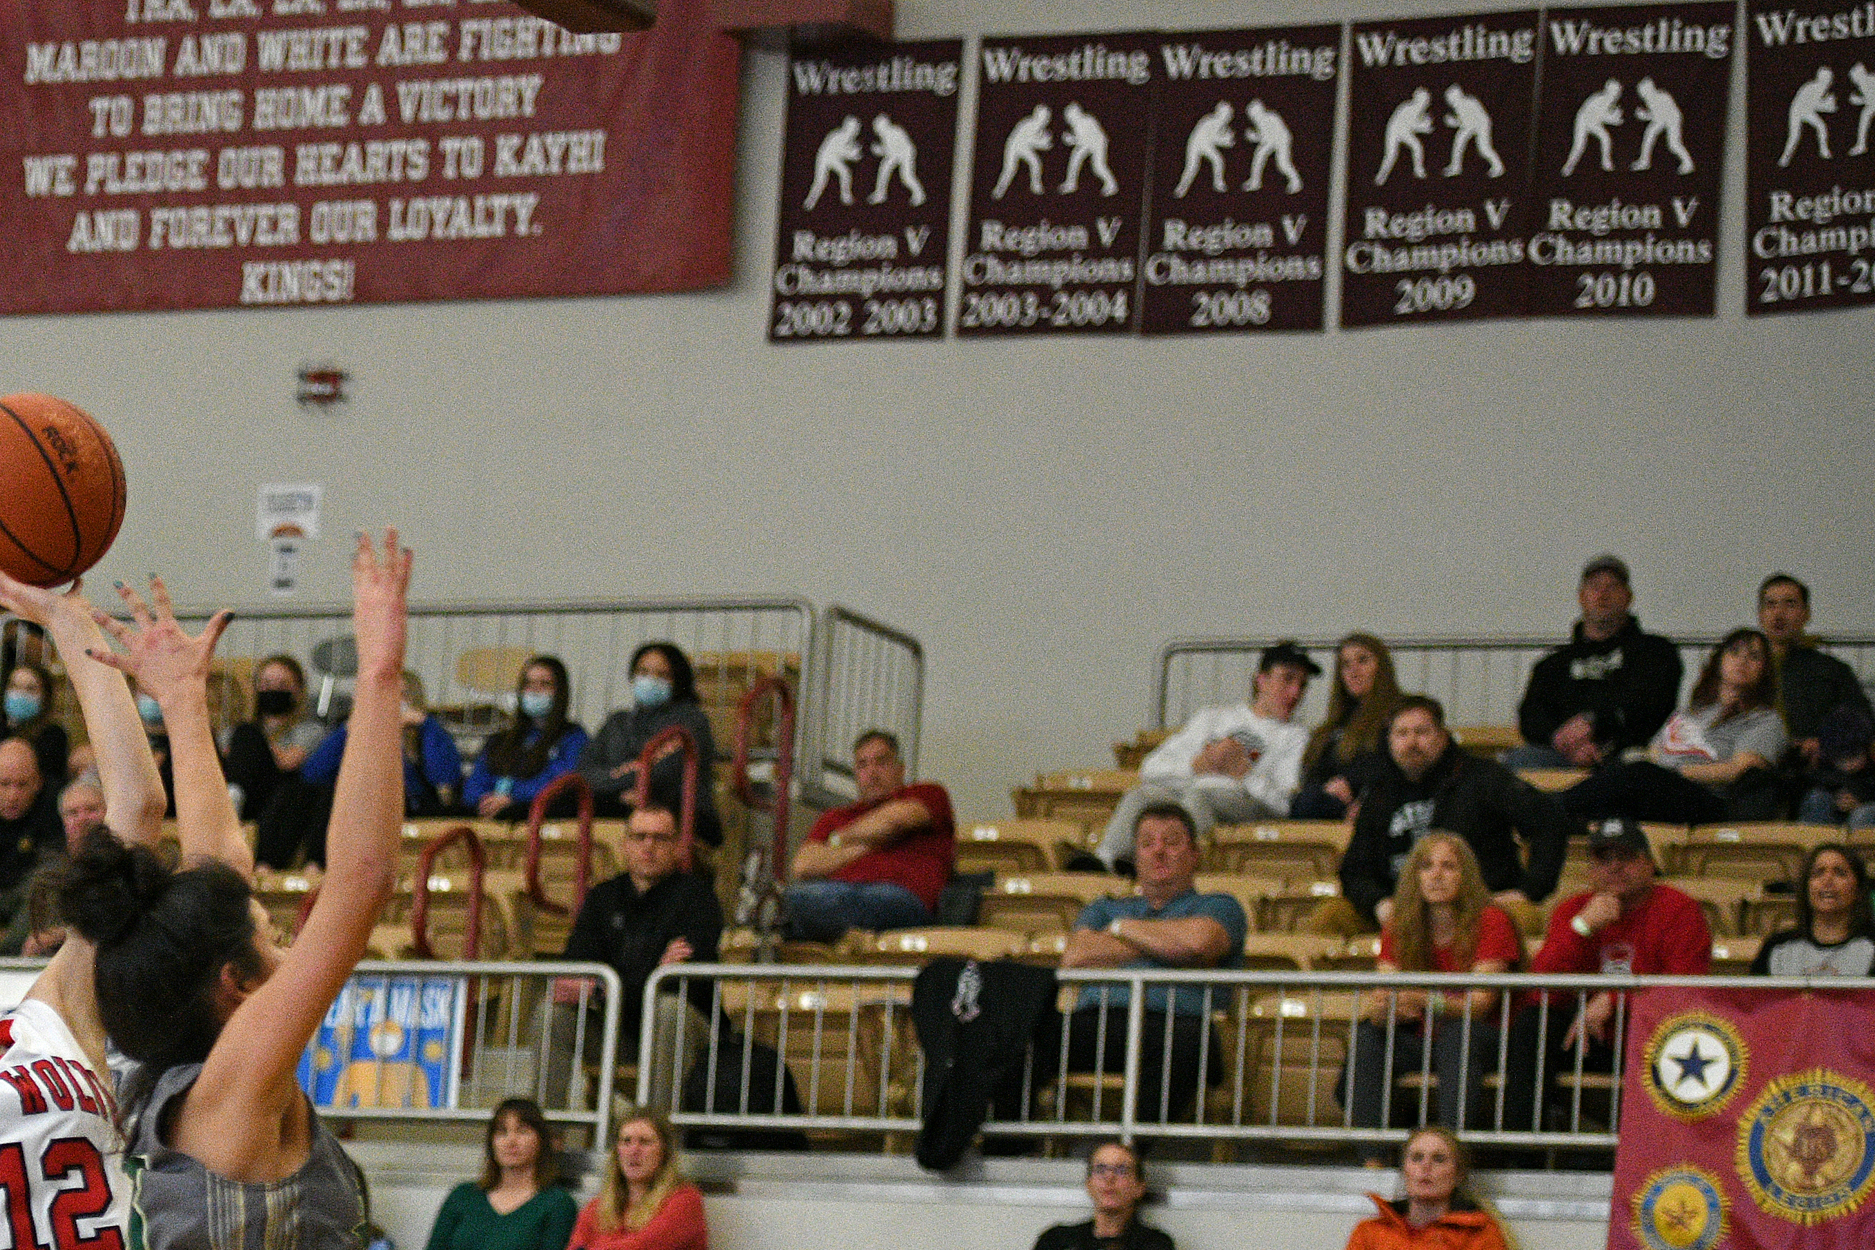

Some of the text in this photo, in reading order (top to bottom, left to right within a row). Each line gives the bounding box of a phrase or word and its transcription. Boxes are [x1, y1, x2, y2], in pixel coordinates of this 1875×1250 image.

[27, 36, 166, 83] MAROON
[173, 33, 247, 77] AND
[257, 25, 370, 73] WHITE
[376, 21, 450, 66] ARE
[1356, 23, 1535, 64] Wrestling
[1550, 18, 1731, 59] Wrestling
[793, 57, 959, 96] Wrestling
[983, 42, 1152, 85] Wrestling
[1161, 40, 1335, 81] Wrestling
[90, 72, 543, 139] TO BRING HOME A VICTORY
[23, 130, 607, 197] WE PLEDGE OUR HEARTS TO KAYHI
[67, 209, 141, 254] AND
[149, 202, 301, 250] FOREVER
[309, 199, 379, 245] OUR
[981, 216, 1122, 257] Region V
[1164, 214, 1307, 256] Region V
[1365, 199, 1512, 242] Region V
[1548, 197, 1698, 236] Region V
[793, 226, 931, 266] Region V
[1345, 235, 1525, 274] Champions
[1528, 232, 1714, 269] Champions
[774, 260, 943, 298] Champions
[964, 253, 1134, 289] Champions
[1145, 251, 1323, 287] Champions
[1760, 258, 1875, 303] 2011-2
[1190, 290, 1272, 328] 2008
[1394, 274, 1476, 315] 2009
[1574, 271, 1656, 310] 2010
